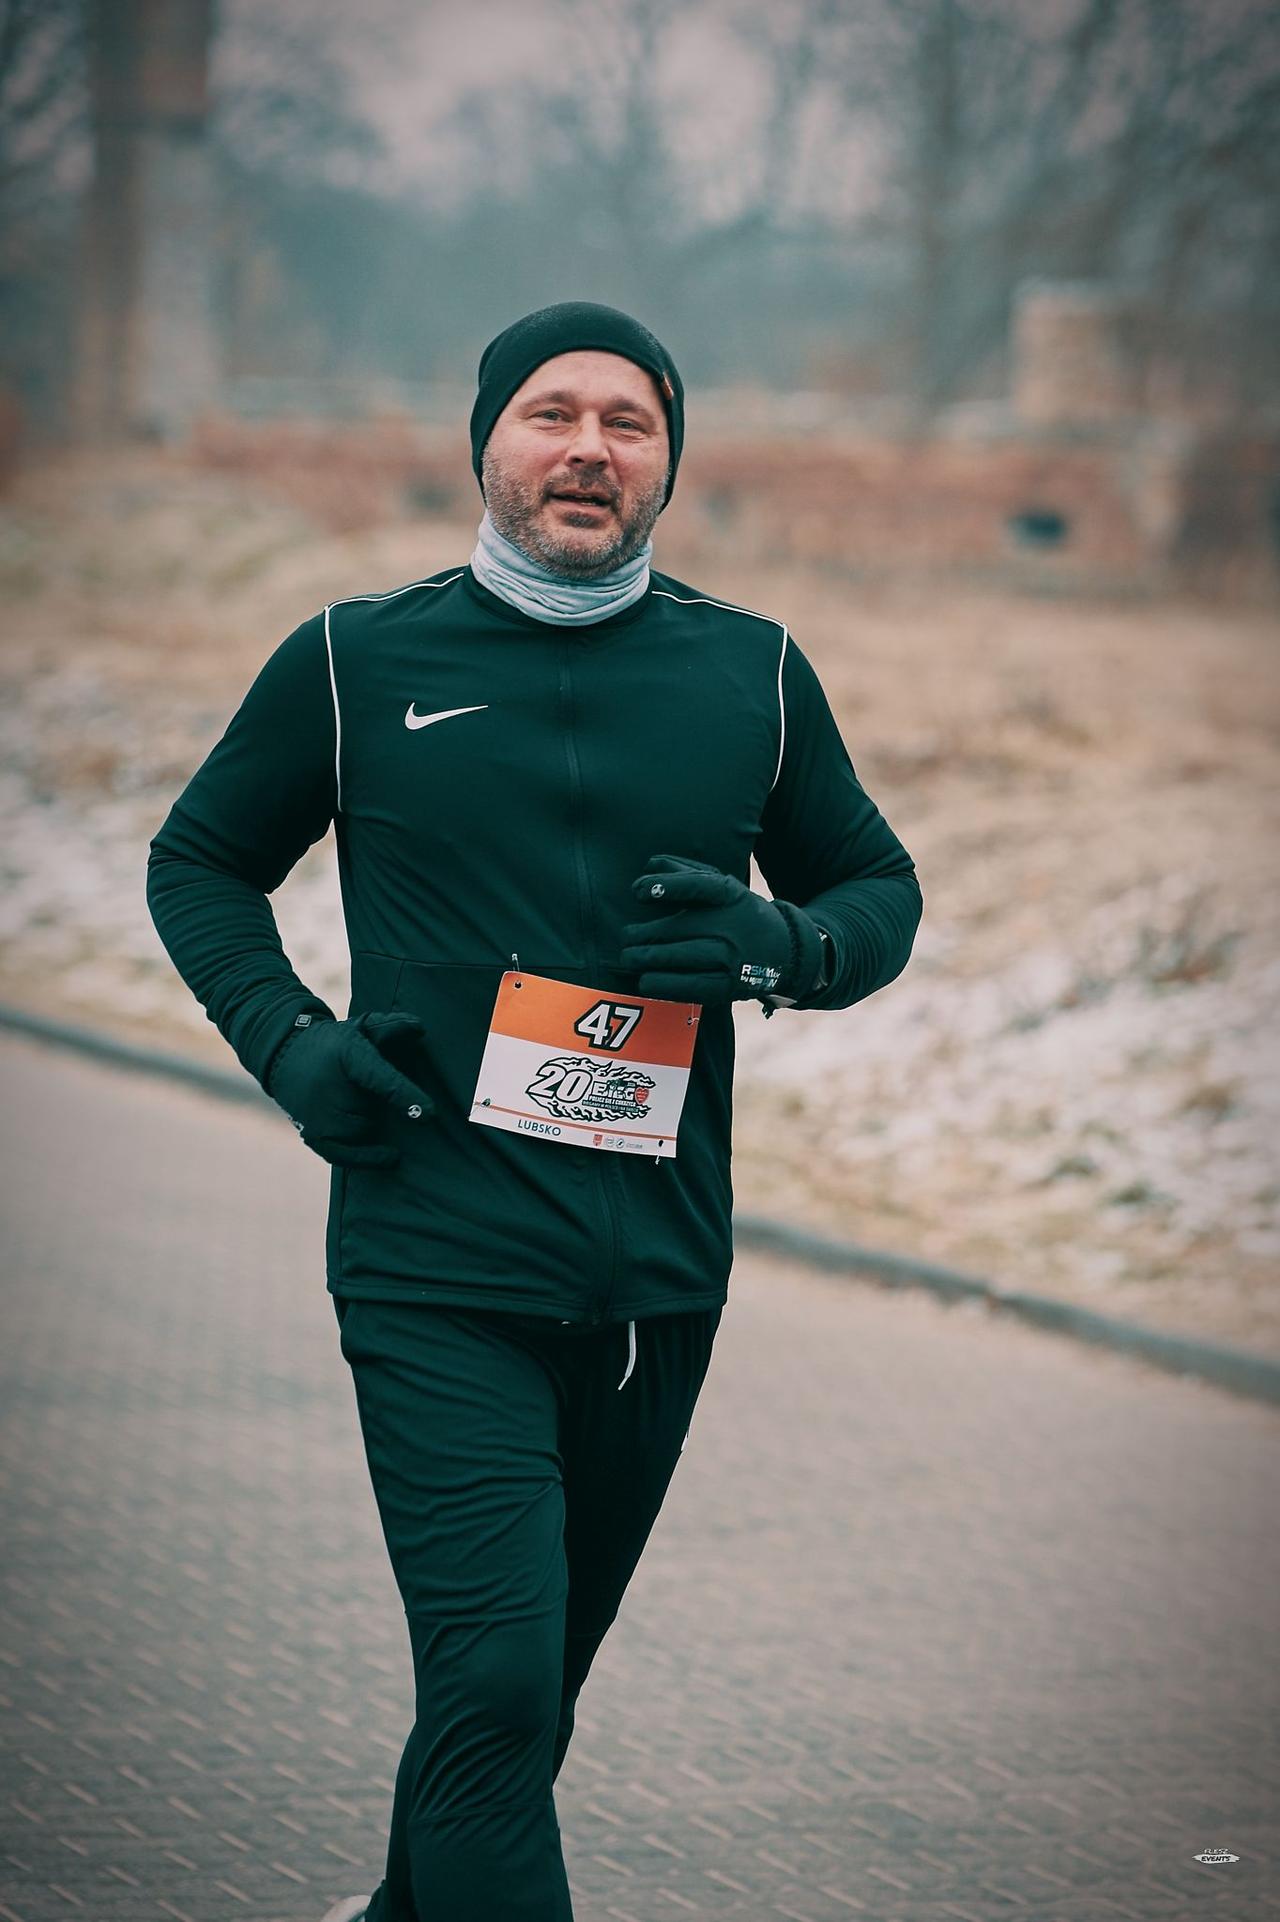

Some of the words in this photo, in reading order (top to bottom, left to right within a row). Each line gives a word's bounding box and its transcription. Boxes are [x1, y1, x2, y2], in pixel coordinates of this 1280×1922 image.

[575, 1001, 643, 1050] 47
[525, 1063, 593, 1103] 20
[517, 1119, 561, 1136] LUBSKO
